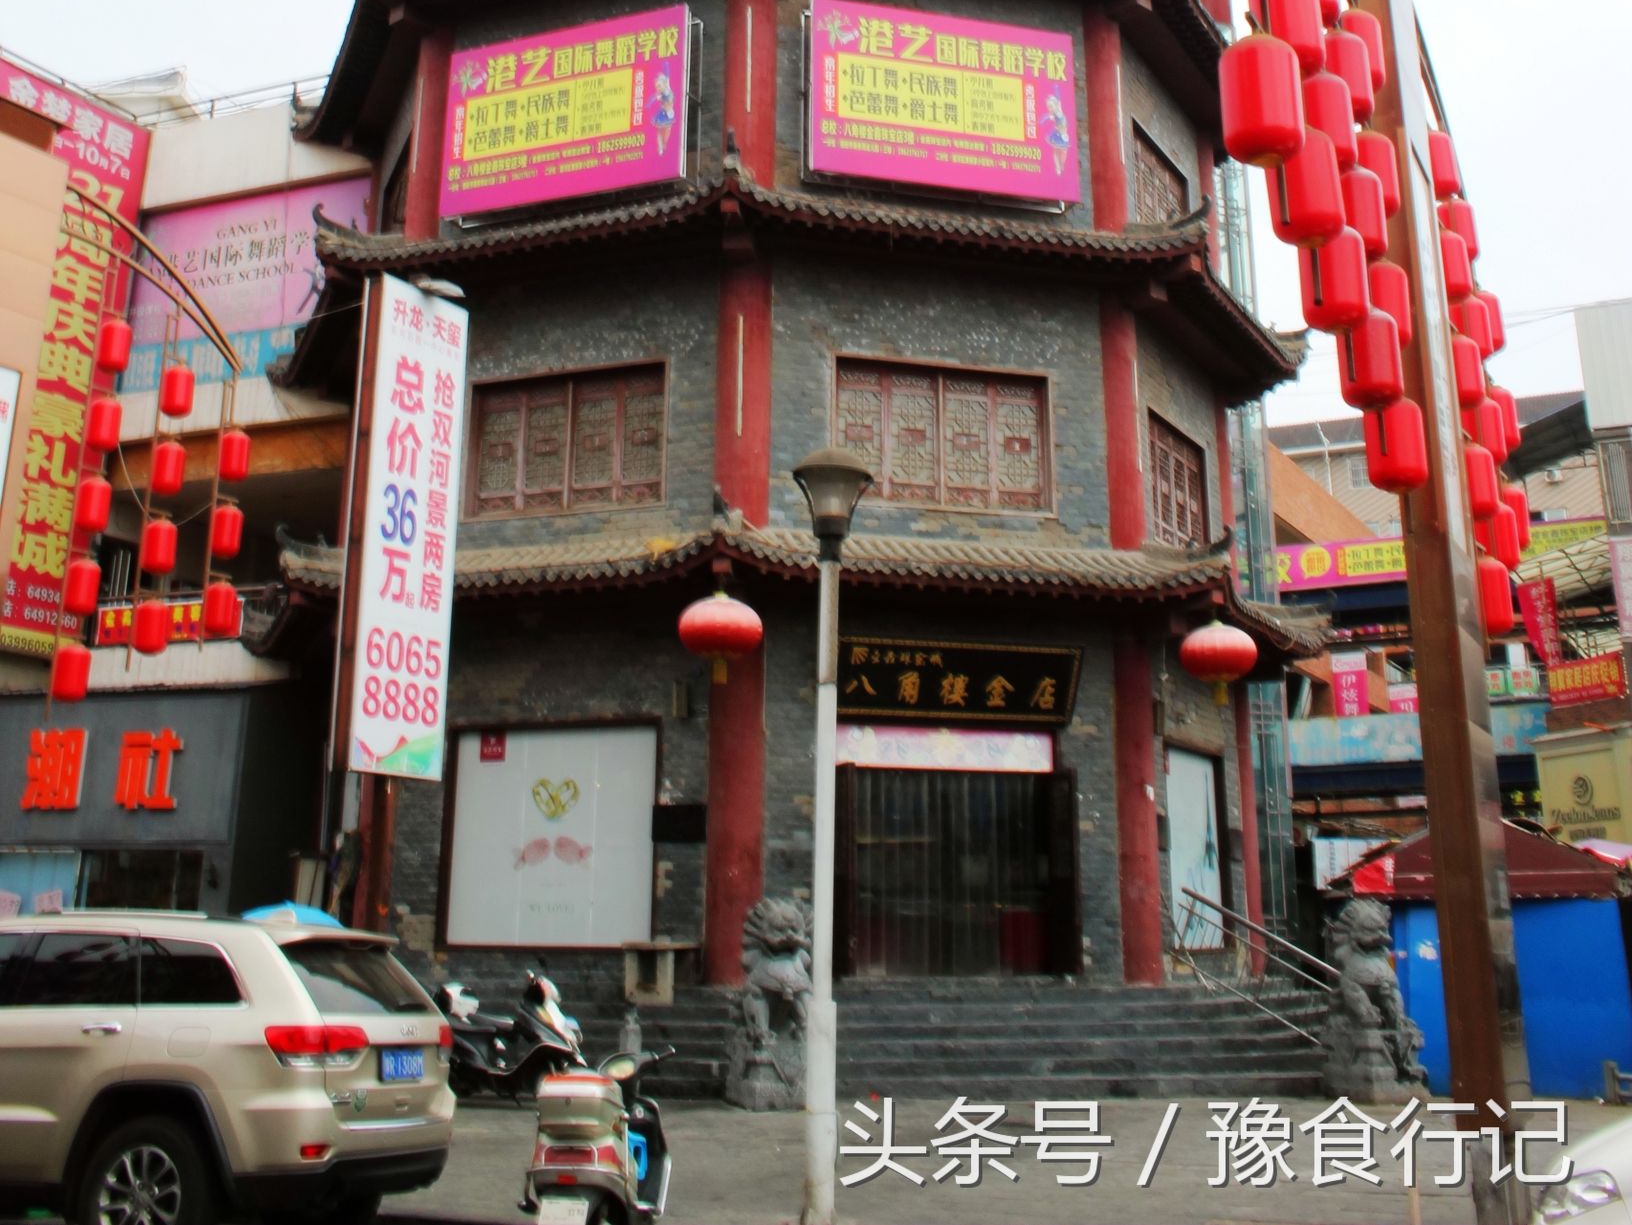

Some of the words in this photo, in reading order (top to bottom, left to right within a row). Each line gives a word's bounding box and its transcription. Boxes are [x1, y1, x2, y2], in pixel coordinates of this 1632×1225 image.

[486, 26, 679, 93] 港艺国际舞蹈学校
[858, 16, 1067, 82] 港艺国际舞蹈学校
[217, 223, 258, 240] GANG
[239, 262, 296, 281] SCHOOL
[366, 627, 442, 680] 6065
[362, 675, 440, 728] 8888
